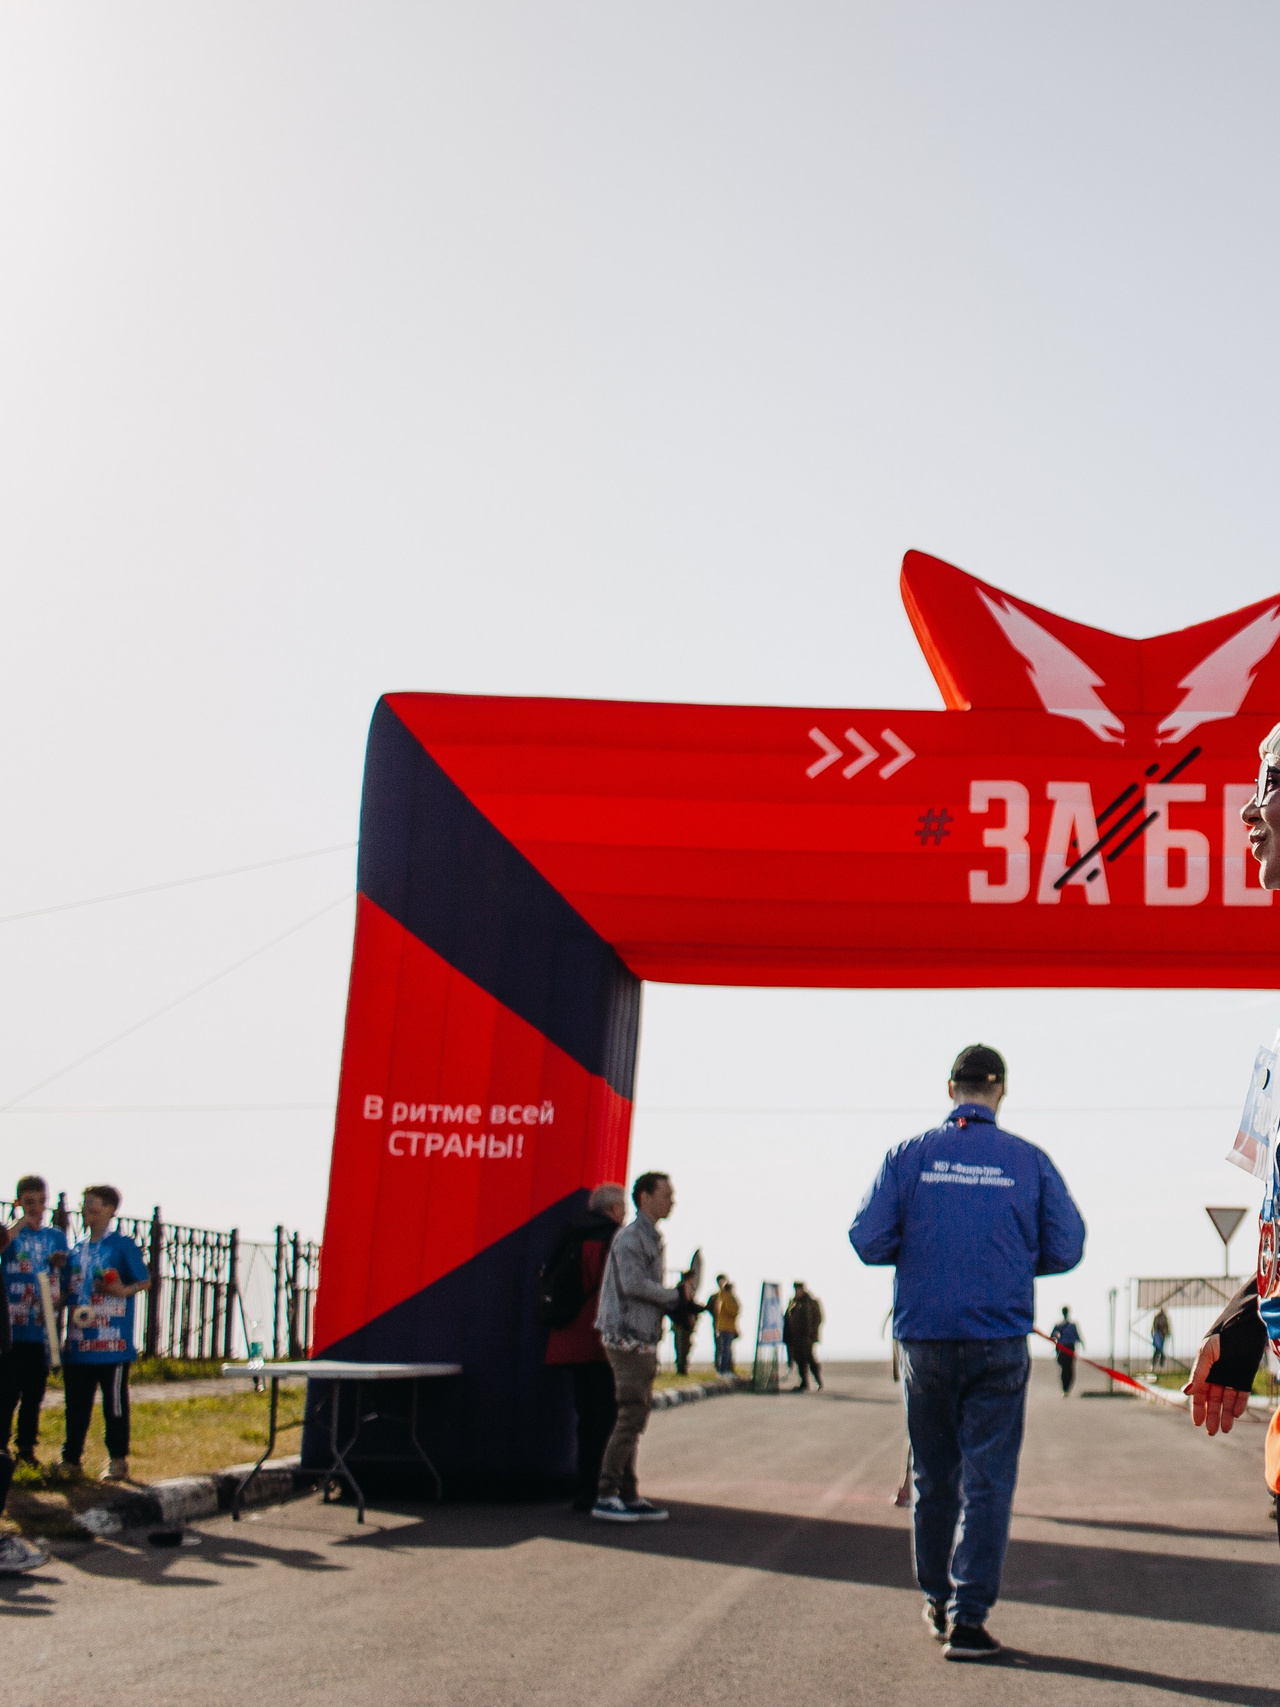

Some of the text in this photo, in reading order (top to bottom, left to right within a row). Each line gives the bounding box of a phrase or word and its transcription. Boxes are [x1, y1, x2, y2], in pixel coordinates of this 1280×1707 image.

[363, 1094, 554, 1125] В ритме всей
[388, 1130, 524, 1159] СТРАНЫ!
